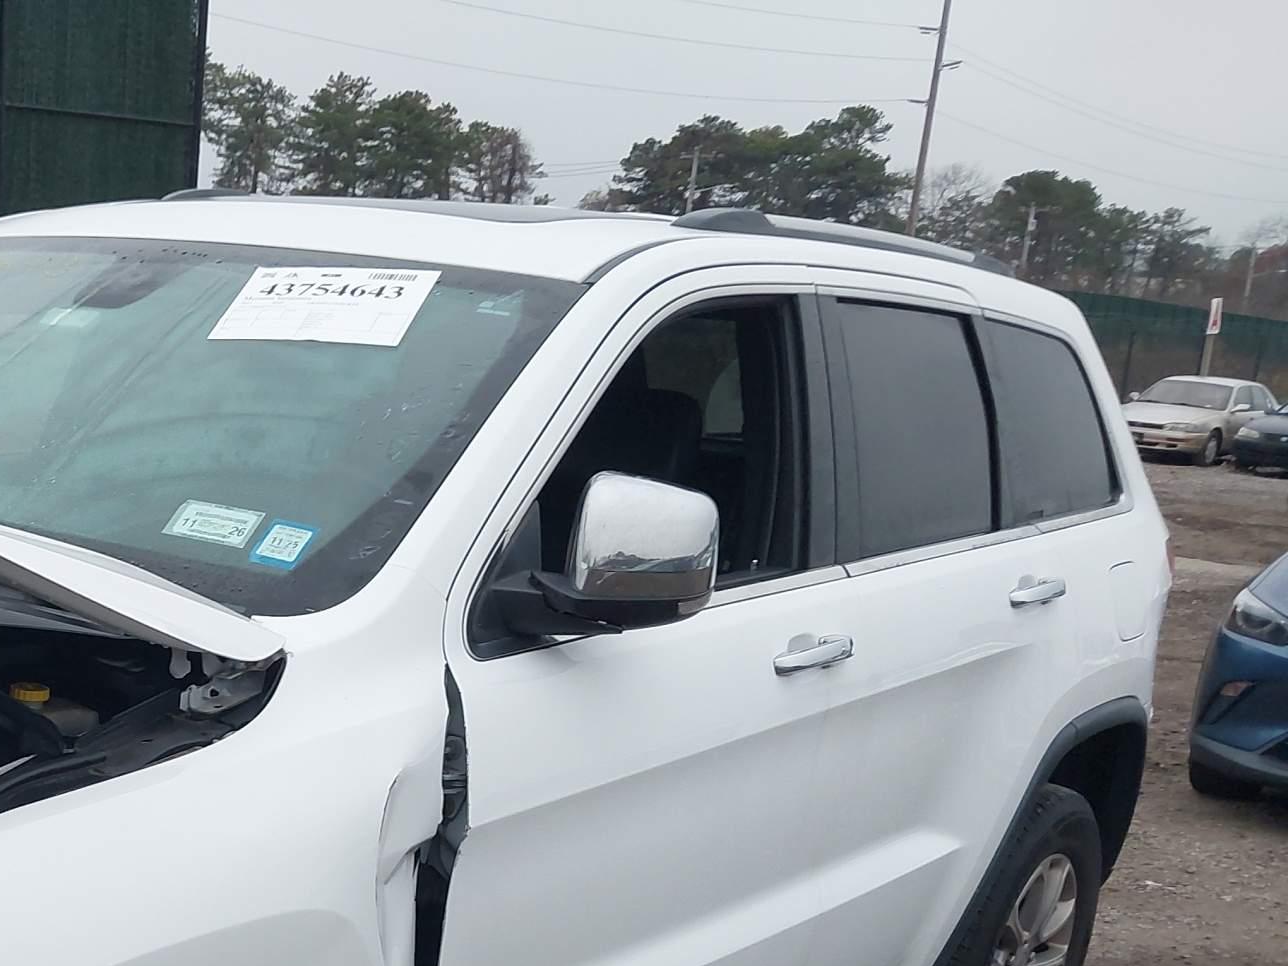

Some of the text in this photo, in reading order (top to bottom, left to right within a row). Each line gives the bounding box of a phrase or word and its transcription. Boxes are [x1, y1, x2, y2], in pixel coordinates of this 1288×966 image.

[259, 283, 405, 299] 43754643
[181, 518, 198, 528] 11
[228, 526, 247, 537] 26
